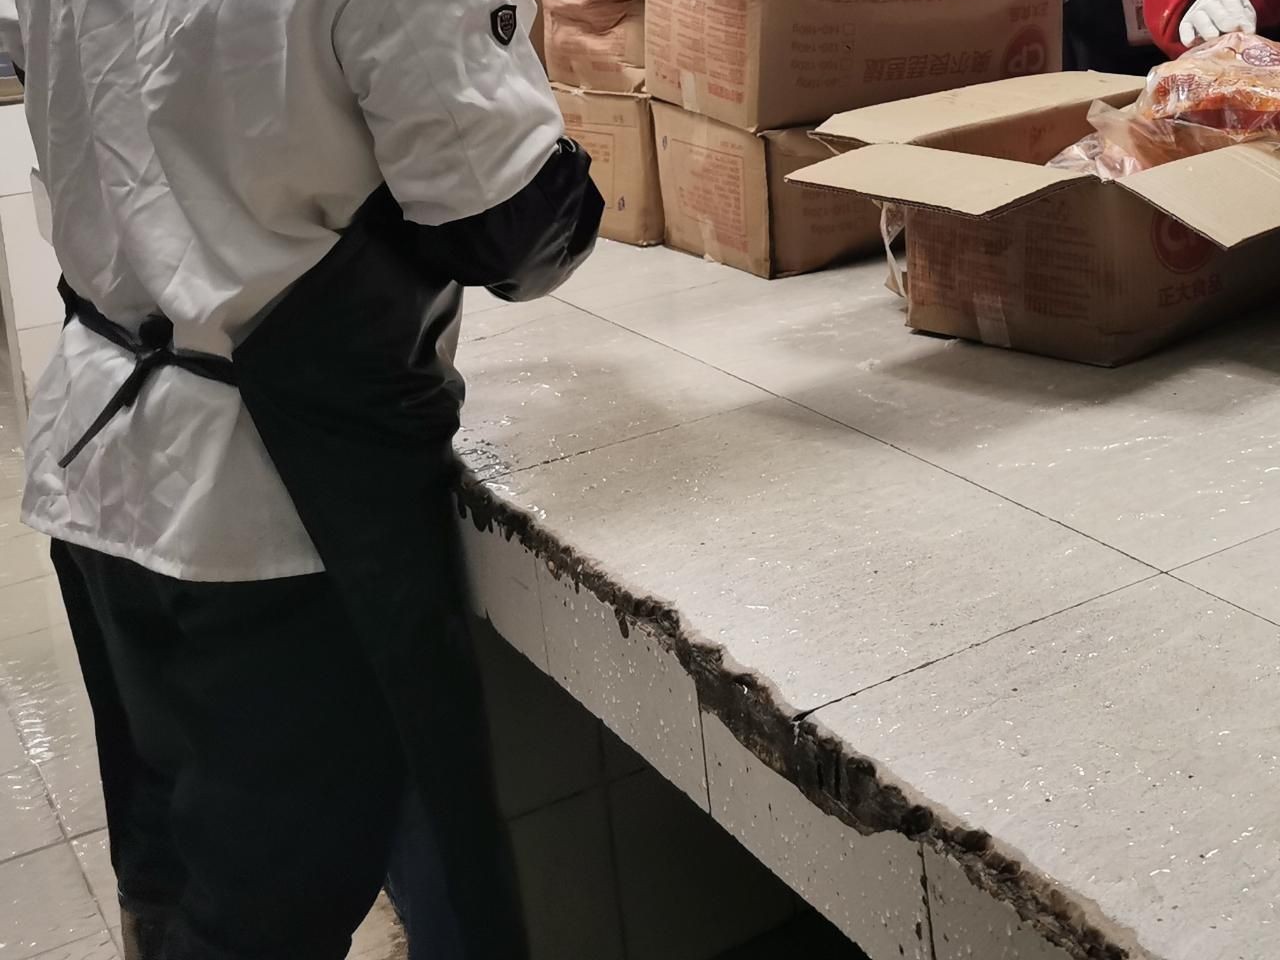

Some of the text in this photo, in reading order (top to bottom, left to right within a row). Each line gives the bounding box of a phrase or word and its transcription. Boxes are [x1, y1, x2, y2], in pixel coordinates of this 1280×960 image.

[1010, 42, 1046, 74] CP
[1158, 273, 1222, 307] 正大食品
